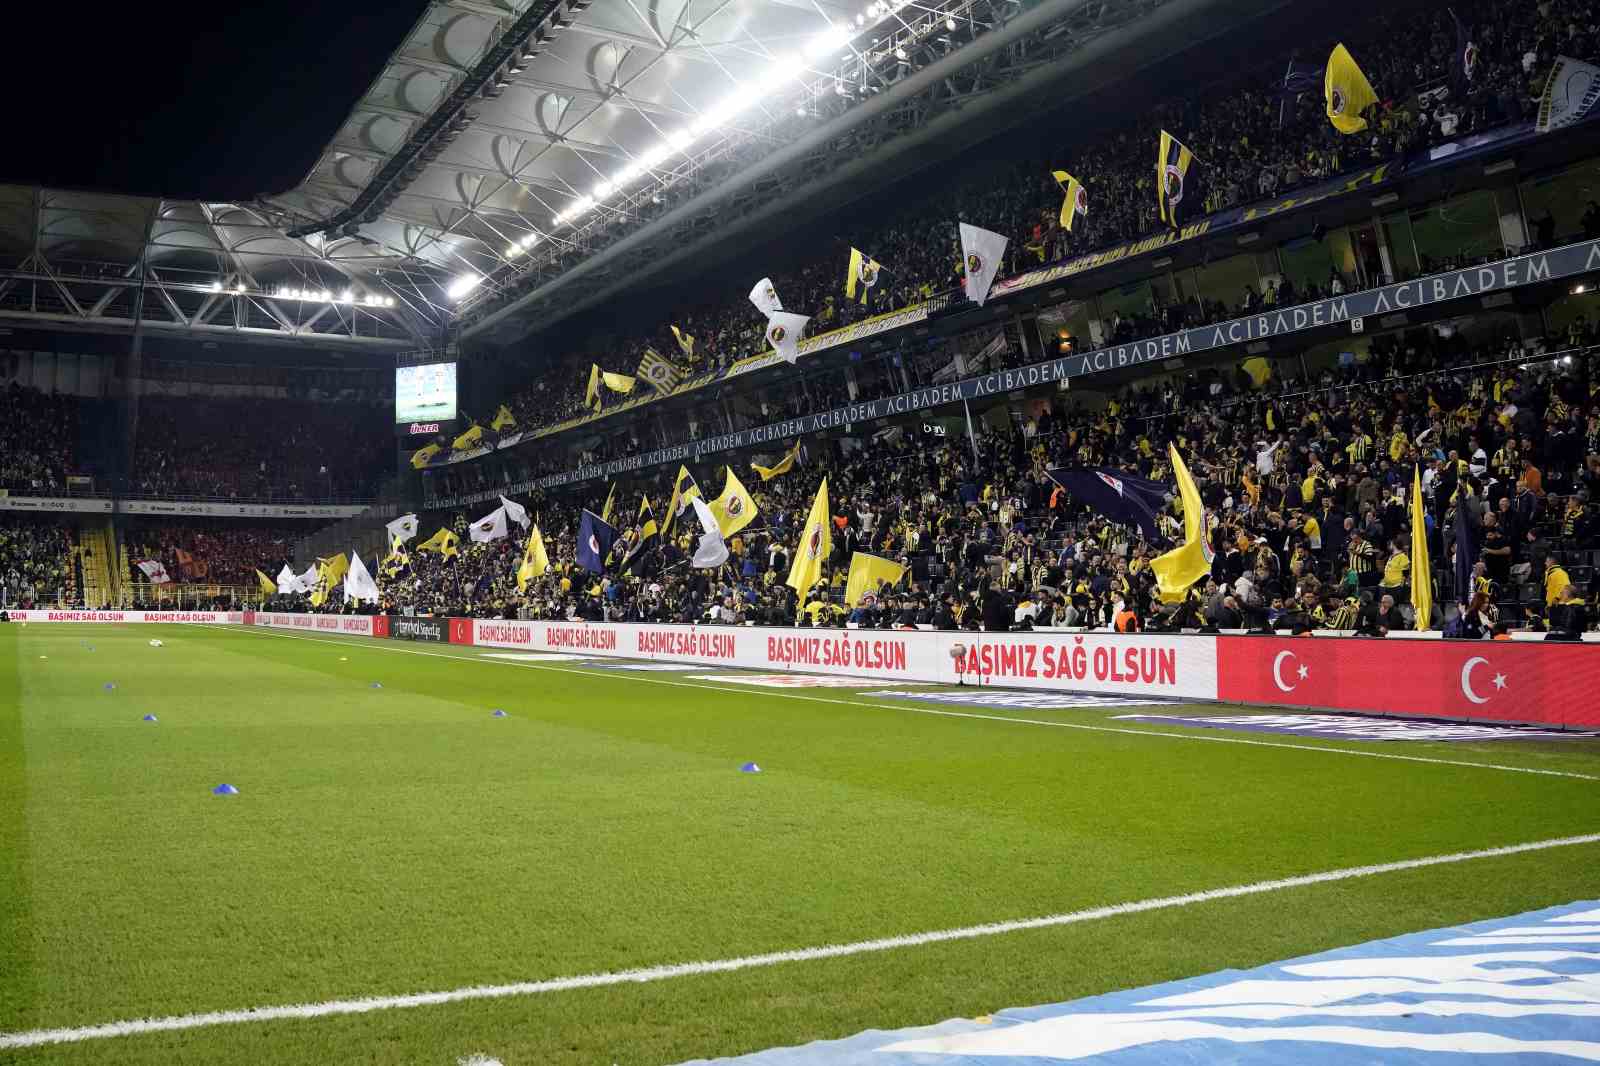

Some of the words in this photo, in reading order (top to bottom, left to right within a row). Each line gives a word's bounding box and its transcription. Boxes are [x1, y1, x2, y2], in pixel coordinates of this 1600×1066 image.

[1354, 320, 1361, 329] G
[648, 446, 689, 465] ACIBADEM
[695, 435, 743, 456] ACIBADEM
[749, 423, 805, 444] ACIBADEM
[813, 404, 876, 430] ACIBADEM
[886, 384, 962, 415] ACIBADEM
[975, 361, 1065, 396] ACIBADEM
[1081, 334, 1191, 375] ACIBADEM
[1212, 299, 1348, 346] ACIBADEM
[1374, 255, 1552, 313] ACIBADEM
[98, 612, 124, 621] OLSUN
[512, 626, 531, 644] OLSUN
[575, 624, 589, 648] SAĞ
[591, 629, 616, 650] OLSUN
[638, 631, 675, 658] BAŞIMIZ
[677, 626, 696, 655] SAĞ
[699, 634, 735, 658] OLSUN
[767, 636, 820, 668] BAŞIMIZ
[823, 632, 851, 666] SAĞ
[854, 640, 906, 670] OLSUN
[1042, 636, 1087, 680] SAĞ
[1093, 646, 1176, 685] OLSUN
